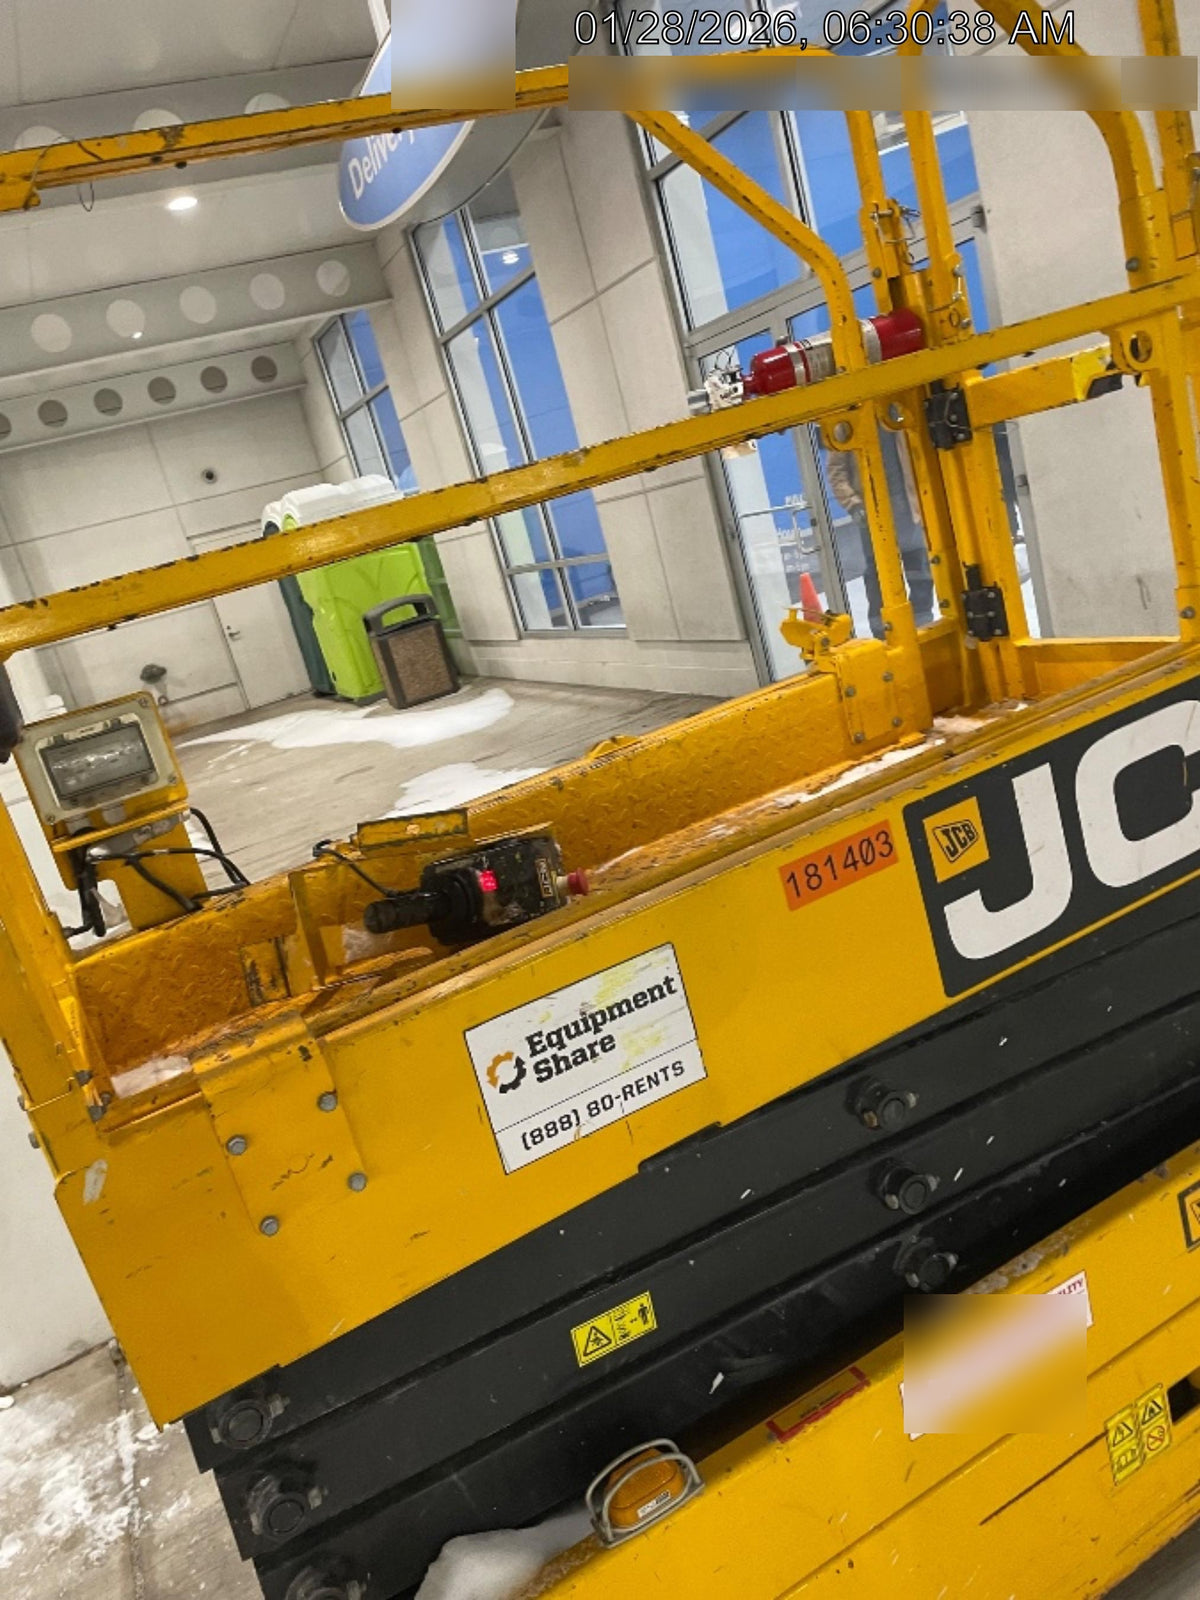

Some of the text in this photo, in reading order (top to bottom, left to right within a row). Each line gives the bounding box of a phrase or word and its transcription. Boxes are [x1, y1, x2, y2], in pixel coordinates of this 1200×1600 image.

[348, 130, 415, 200] Delive
[786, 829, 894, 898] 181403
[938, 820, 978, 859] JCB
[525, 975, 678, 1058] Equipment
[532, 1033, 617, 1083] Share
[521, 1060, 685, 1150] (888) 80-RENTS
